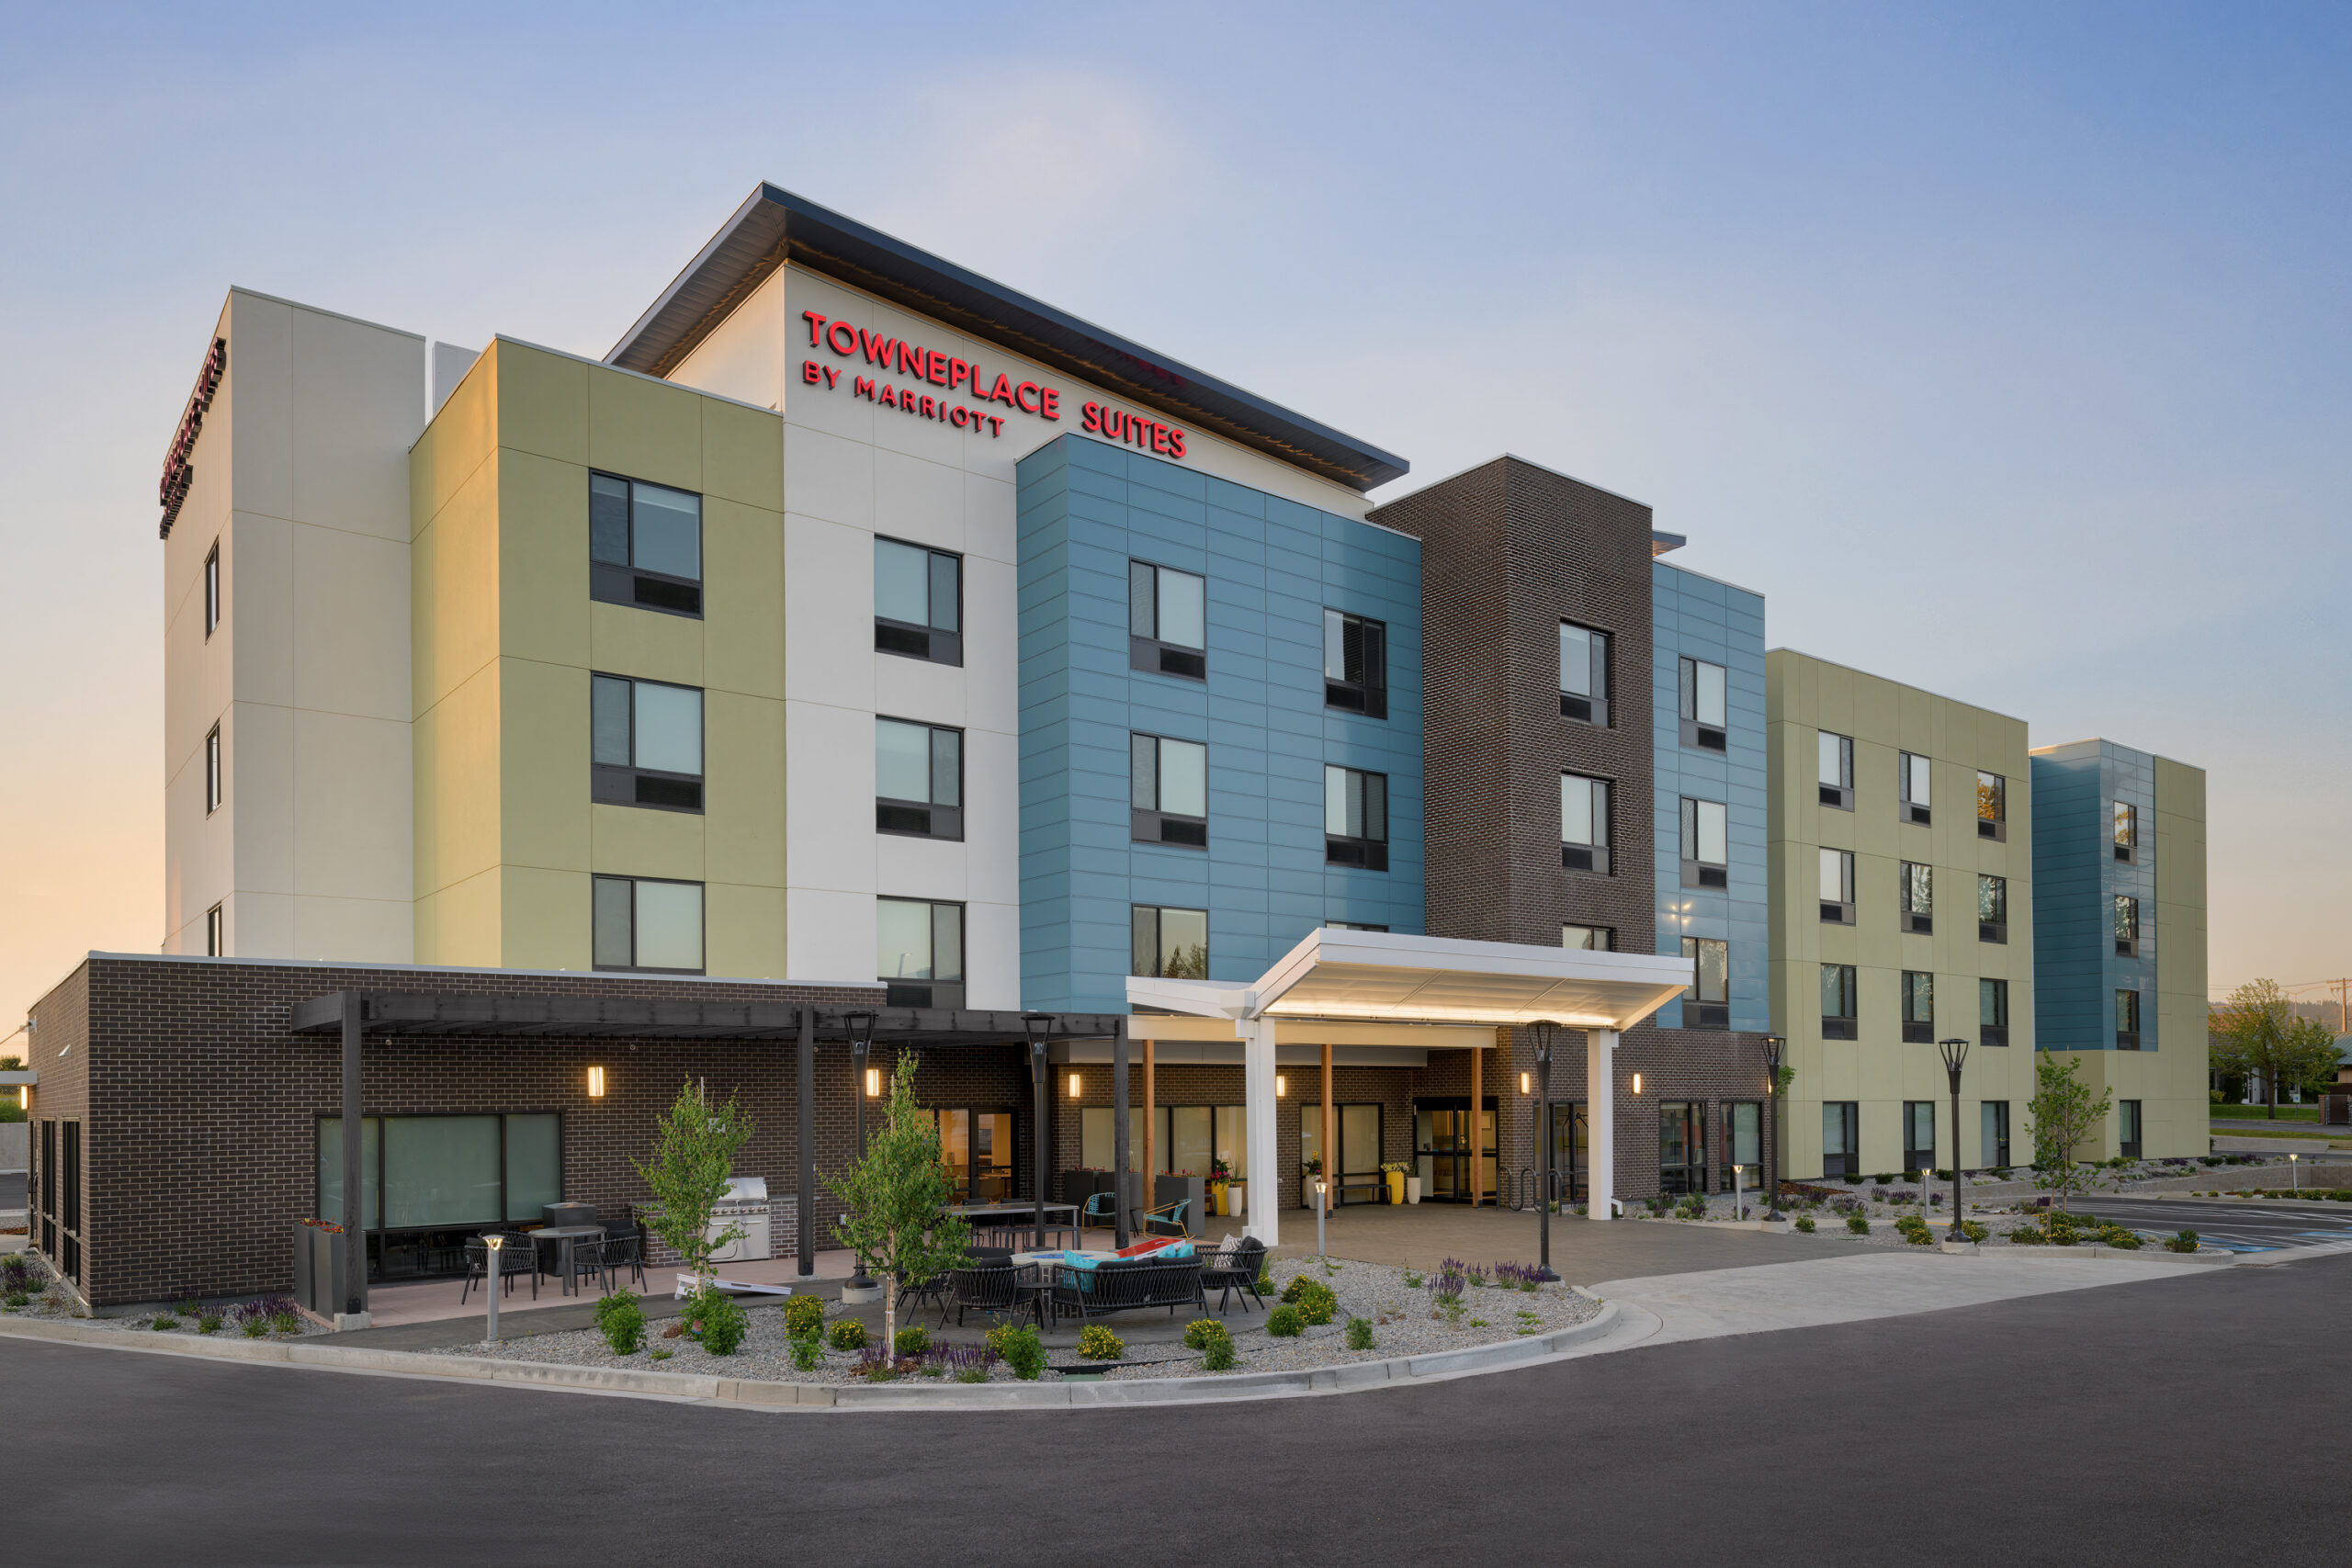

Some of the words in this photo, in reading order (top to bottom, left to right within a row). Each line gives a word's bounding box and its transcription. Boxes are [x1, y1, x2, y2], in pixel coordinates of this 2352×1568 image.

[803, 310, 1059, 420] TOWNEPLACE
[1082, 401, 1187, 457] SUITES
[803, 360, 842, 389] BY
[854, 376, 1005, 437] MARRIOTT
